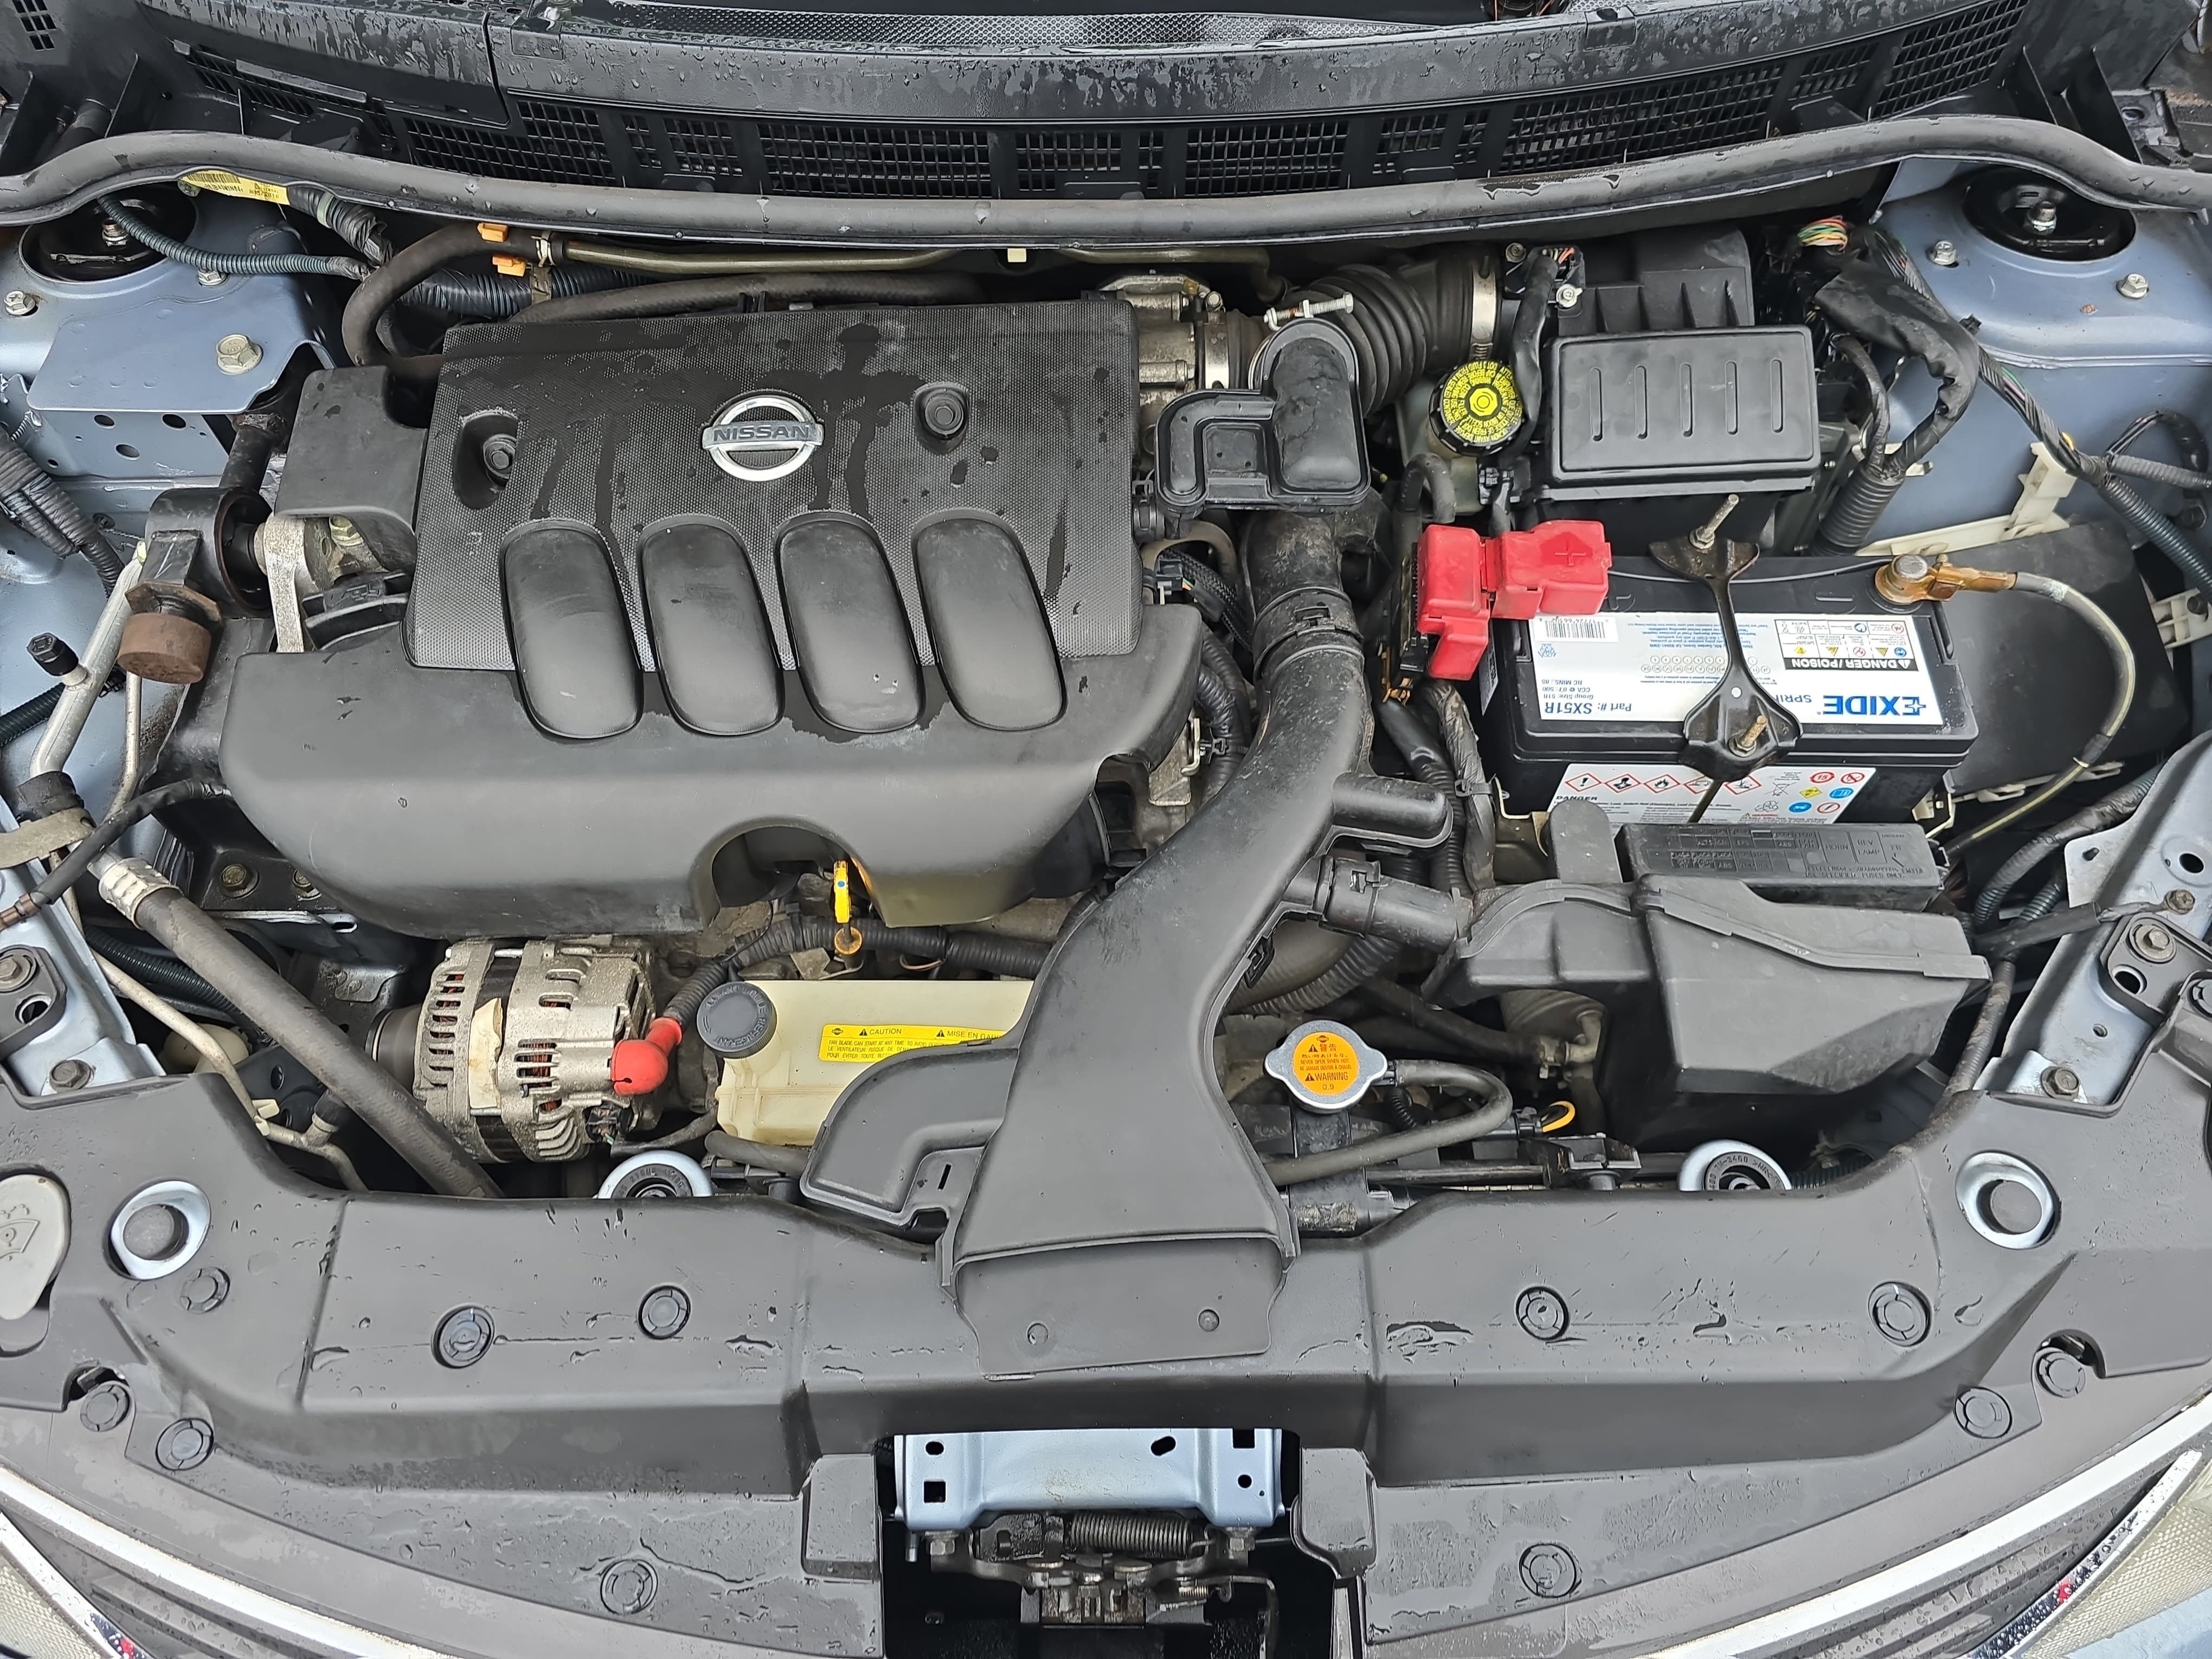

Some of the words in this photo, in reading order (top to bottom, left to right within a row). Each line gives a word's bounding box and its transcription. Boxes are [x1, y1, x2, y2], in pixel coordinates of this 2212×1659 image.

[1468, 361, 1482, 371] FLUID
[1487, 362, 1497, 370] DOT
[1466, 369, 1485, 380] BEFORE
[1486, 370, 1495, 378] CAP
[1451, 375, 1468, 398] REMOVING
[1469, 377, 1491, 387] WARNING
[1443, 380, 1456, 398] SEALED
[1459, 383, 1471, 398] CLEAN
[1443, 398, 1455, 425] CONTAINER
[714, 425, 809, 442] NISSAN
[1845, 659, 1898, 668] DANGER
[1545, 702, 1592, 714] SX51R
[1610, 703, 1632, 711] Part
[1823, 696, 1926, 716] EXIDE
[1320, 1043, 1337, 1052] 警告
[1315, 1072, 1348, 1081] WARNING
